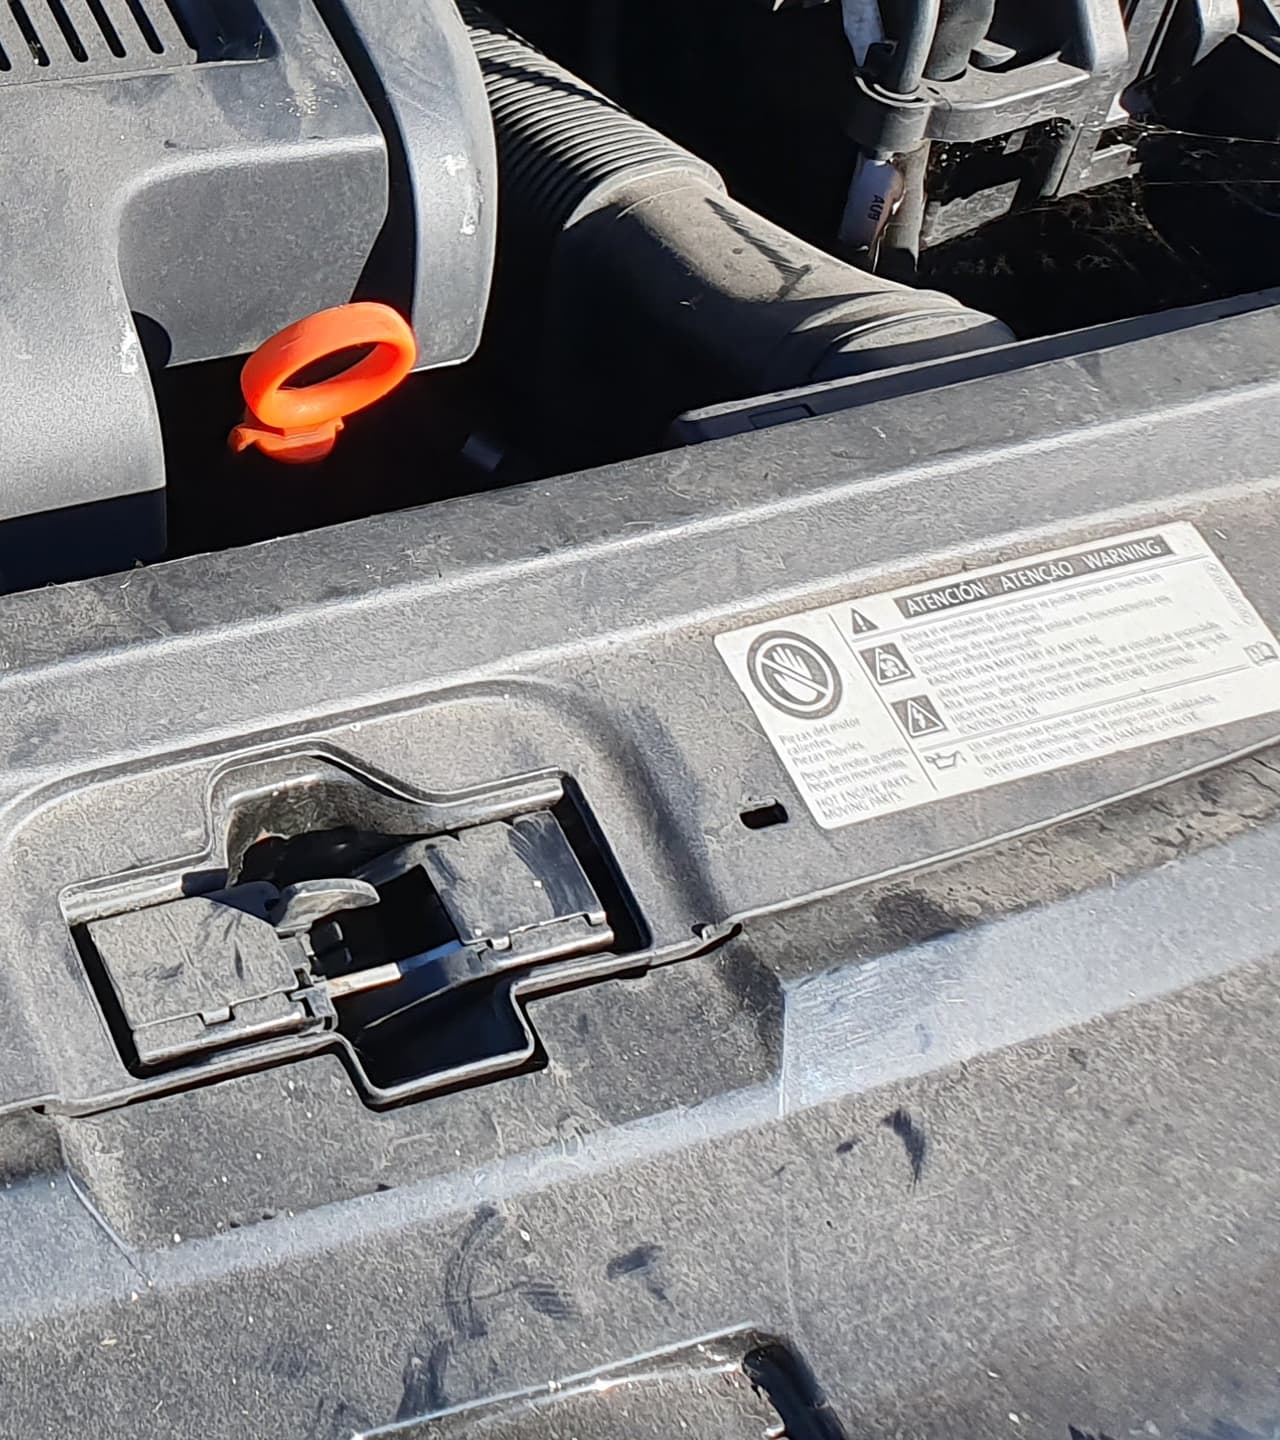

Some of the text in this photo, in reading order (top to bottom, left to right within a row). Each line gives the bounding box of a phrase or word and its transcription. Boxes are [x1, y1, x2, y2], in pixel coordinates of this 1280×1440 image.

[905, 539, 1162, 615] ATENCIÓN ATENÇÃO WARNING
[778, 717, 861, 746] Piezas del motor
[791, 752, 825, 767] Piezas
[814, 794, 839, 809] HOT
[839, 783, 881, 802] ENGINE
[821, 800, 869, 819] MOVING
